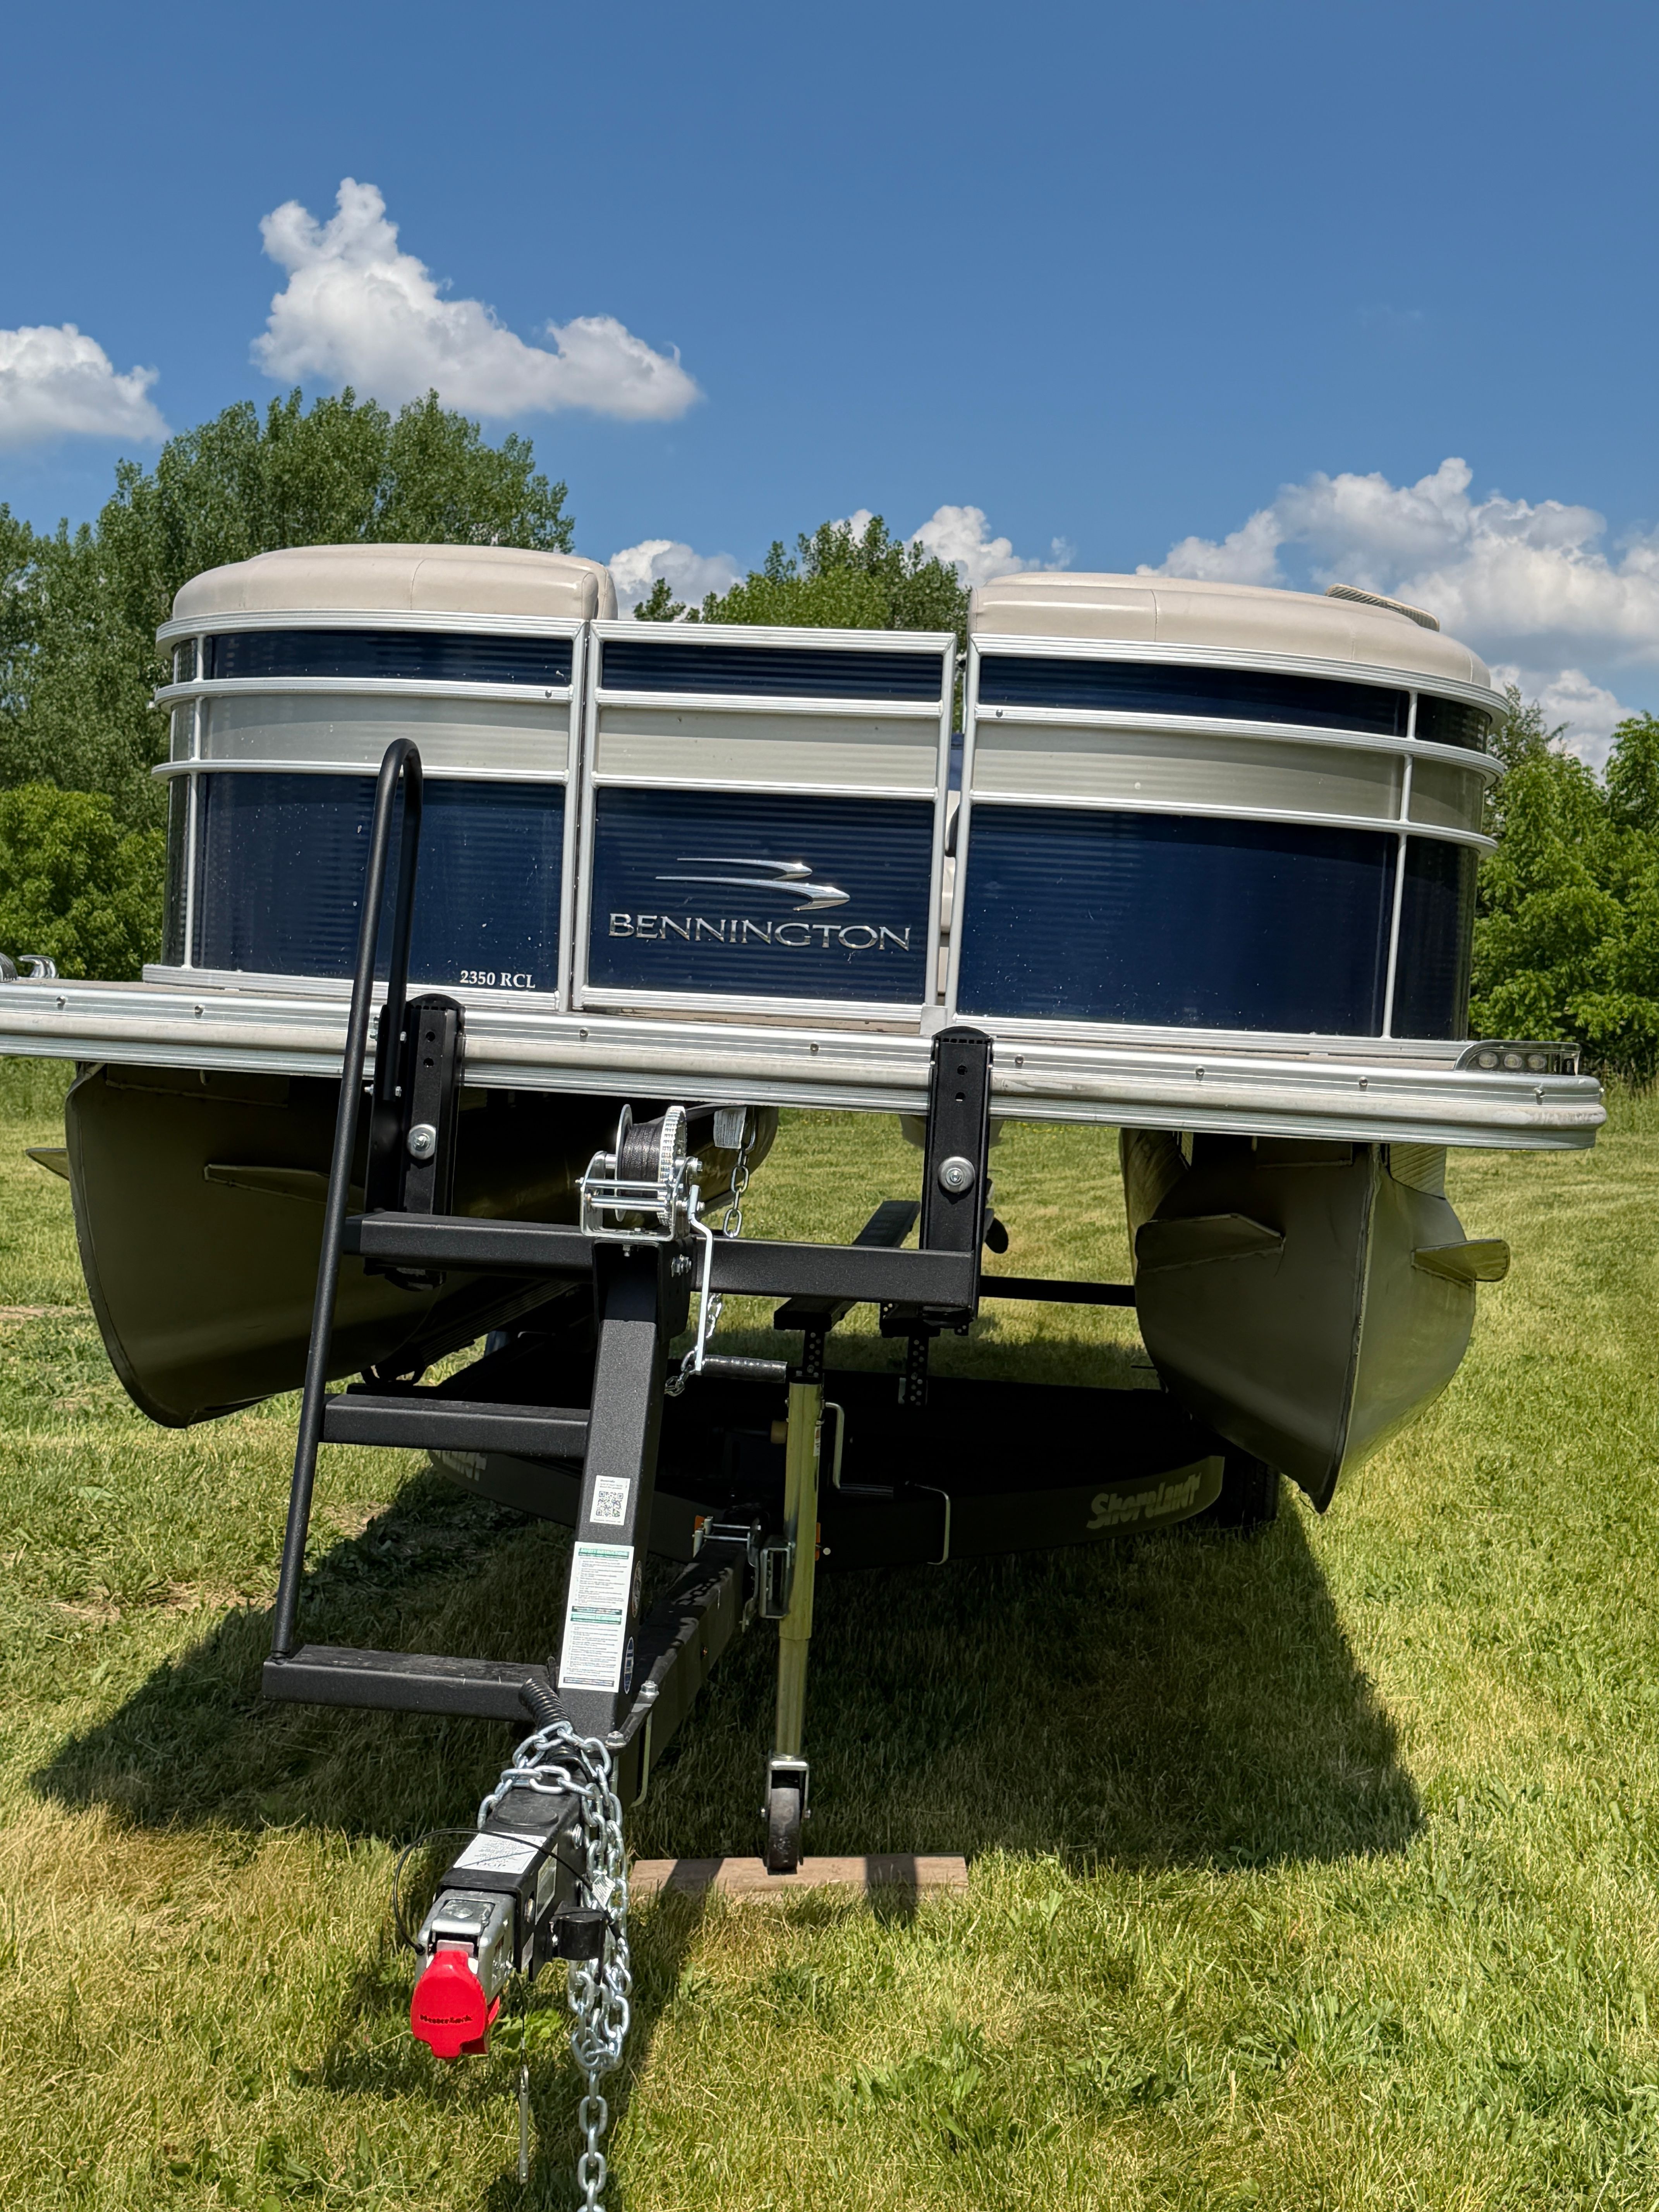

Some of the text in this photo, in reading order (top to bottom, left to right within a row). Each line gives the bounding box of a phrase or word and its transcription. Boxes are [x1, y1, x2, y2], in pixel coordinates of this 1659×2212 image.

[608, 913, 910, 951] BENNINGTON
[460, 970, 536, 989] 2350 RCL
